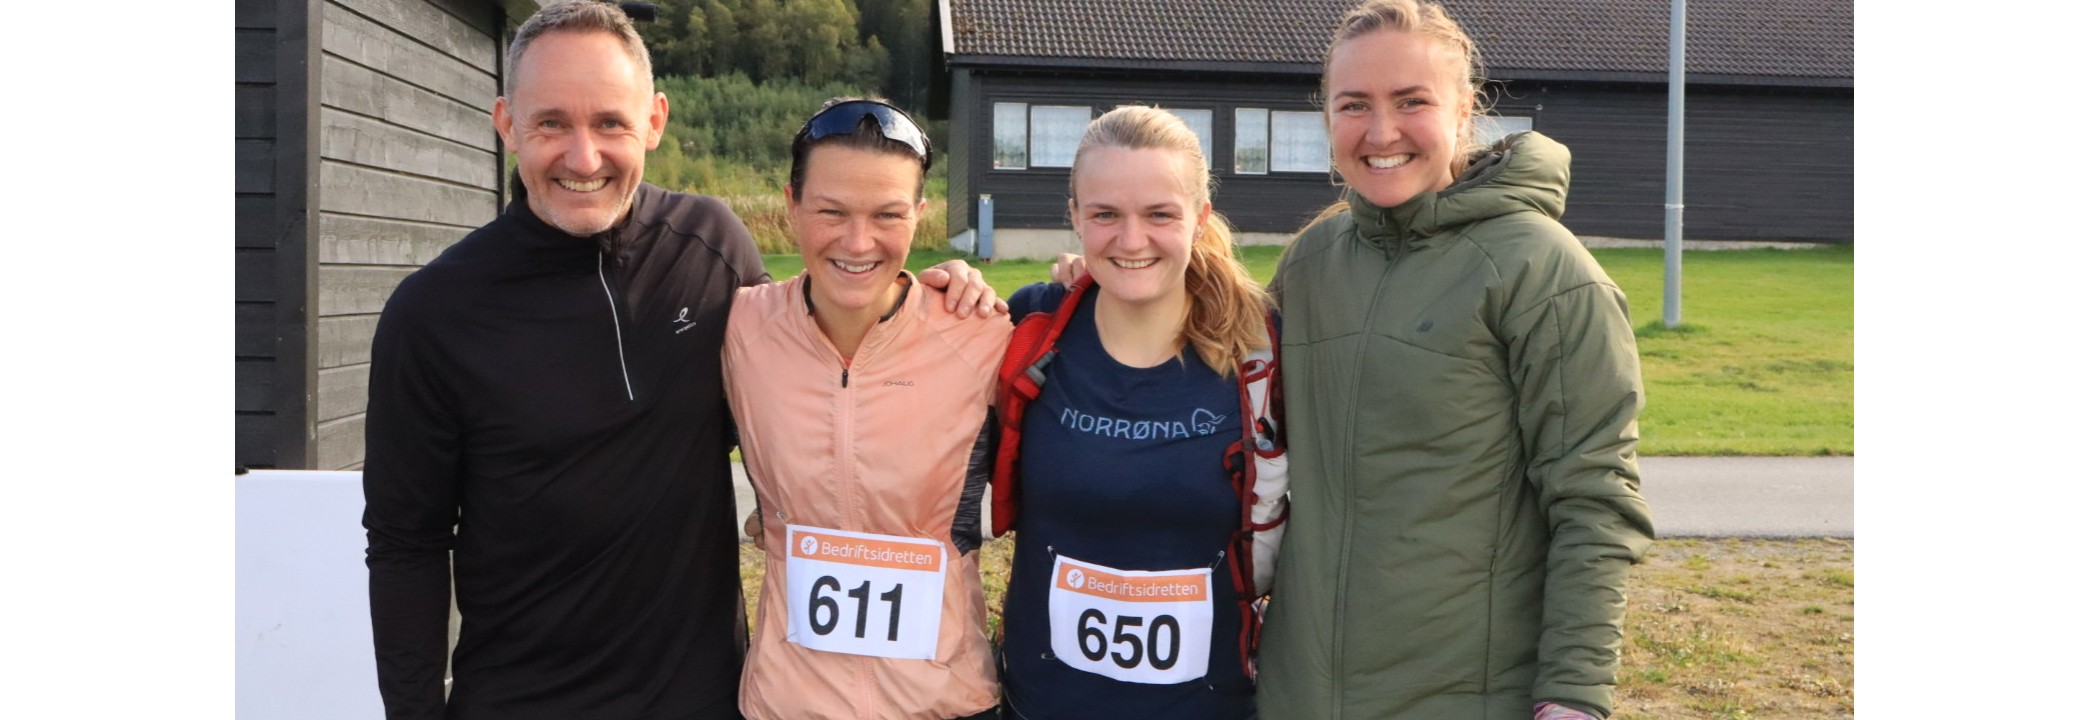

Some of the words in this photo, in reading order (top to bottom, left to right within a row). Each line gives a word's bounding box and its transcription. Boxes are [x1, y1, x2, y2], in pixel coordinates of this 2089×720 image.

[1061, 407, 1190, 439] NORRØNA
[821, 542, 932, 565] Bedriftsidretten
[1087, 577, 1198, 597] Bedriftsidretten
[808, 575, 903, 642] 611
[1077, 608, 1180, 670] 650
